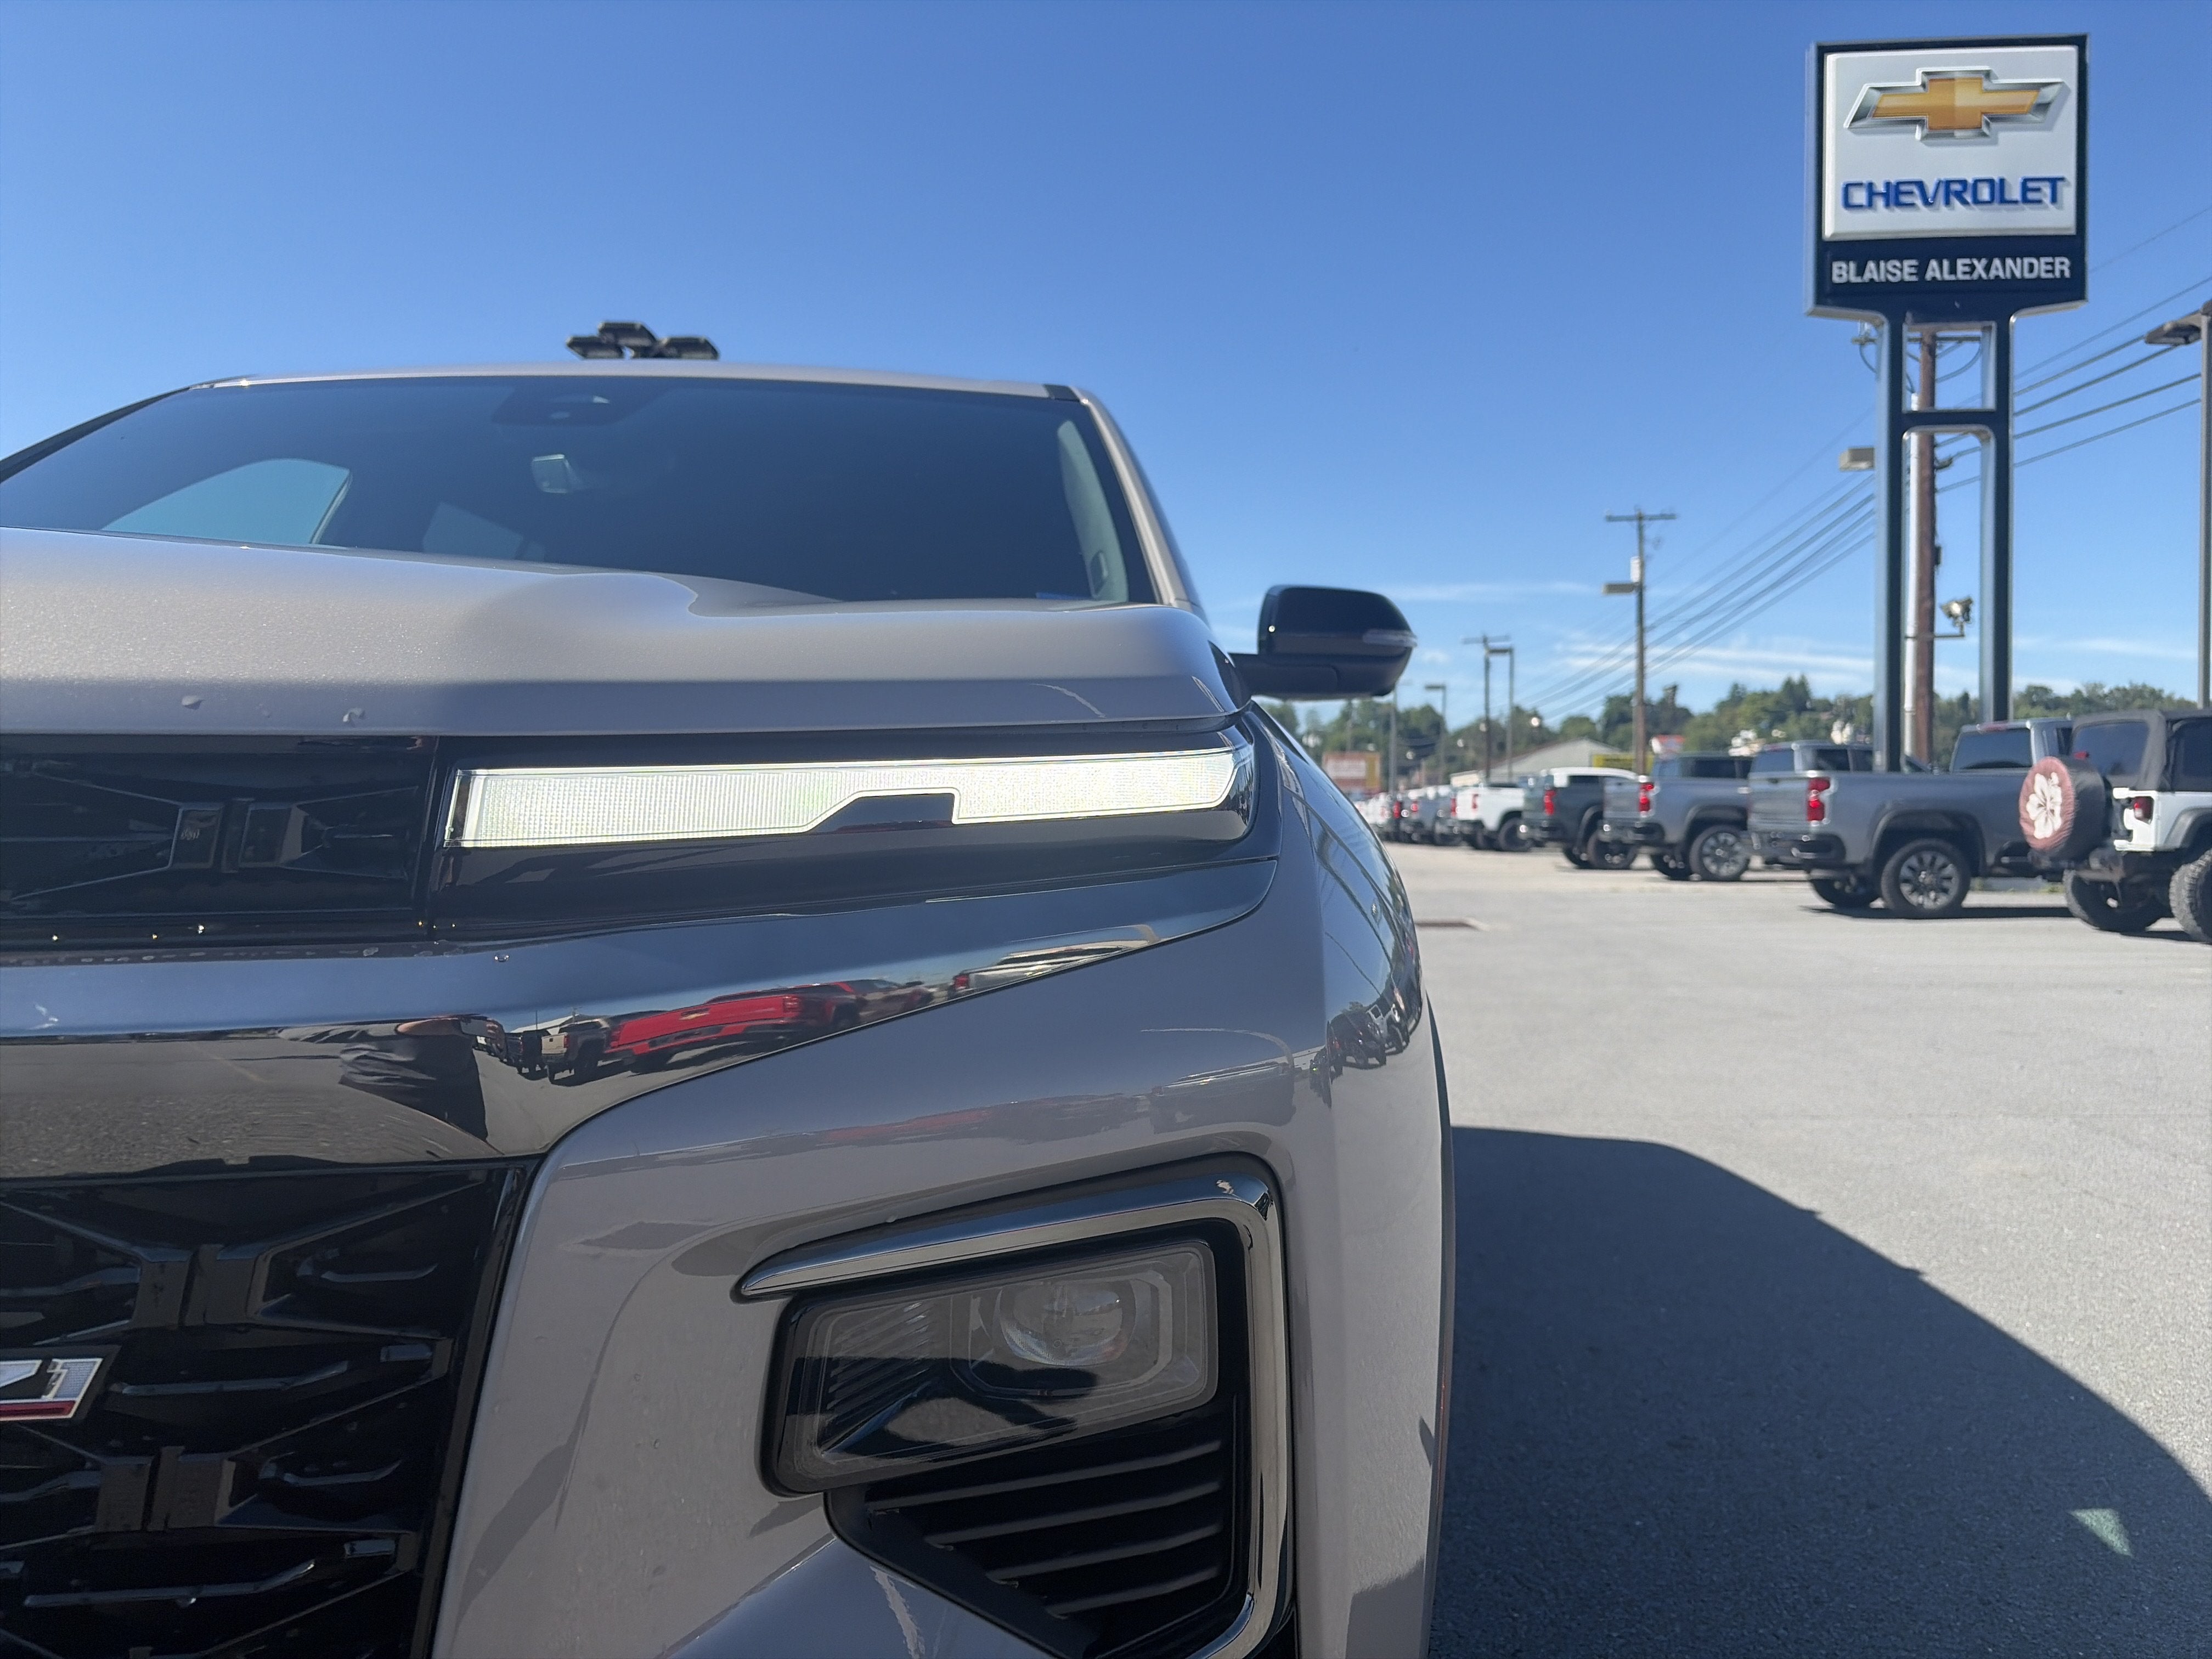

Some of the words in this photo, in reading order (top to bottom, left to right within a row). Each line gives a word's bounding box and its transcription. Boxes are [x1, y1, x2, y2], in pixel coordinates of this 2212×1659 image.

[1842, 176, 2066, 210] CHEVROLET
[1832, 258, 1919, 284] BLAISE
[1925, 256, 2071, 281] ALEXANDER
